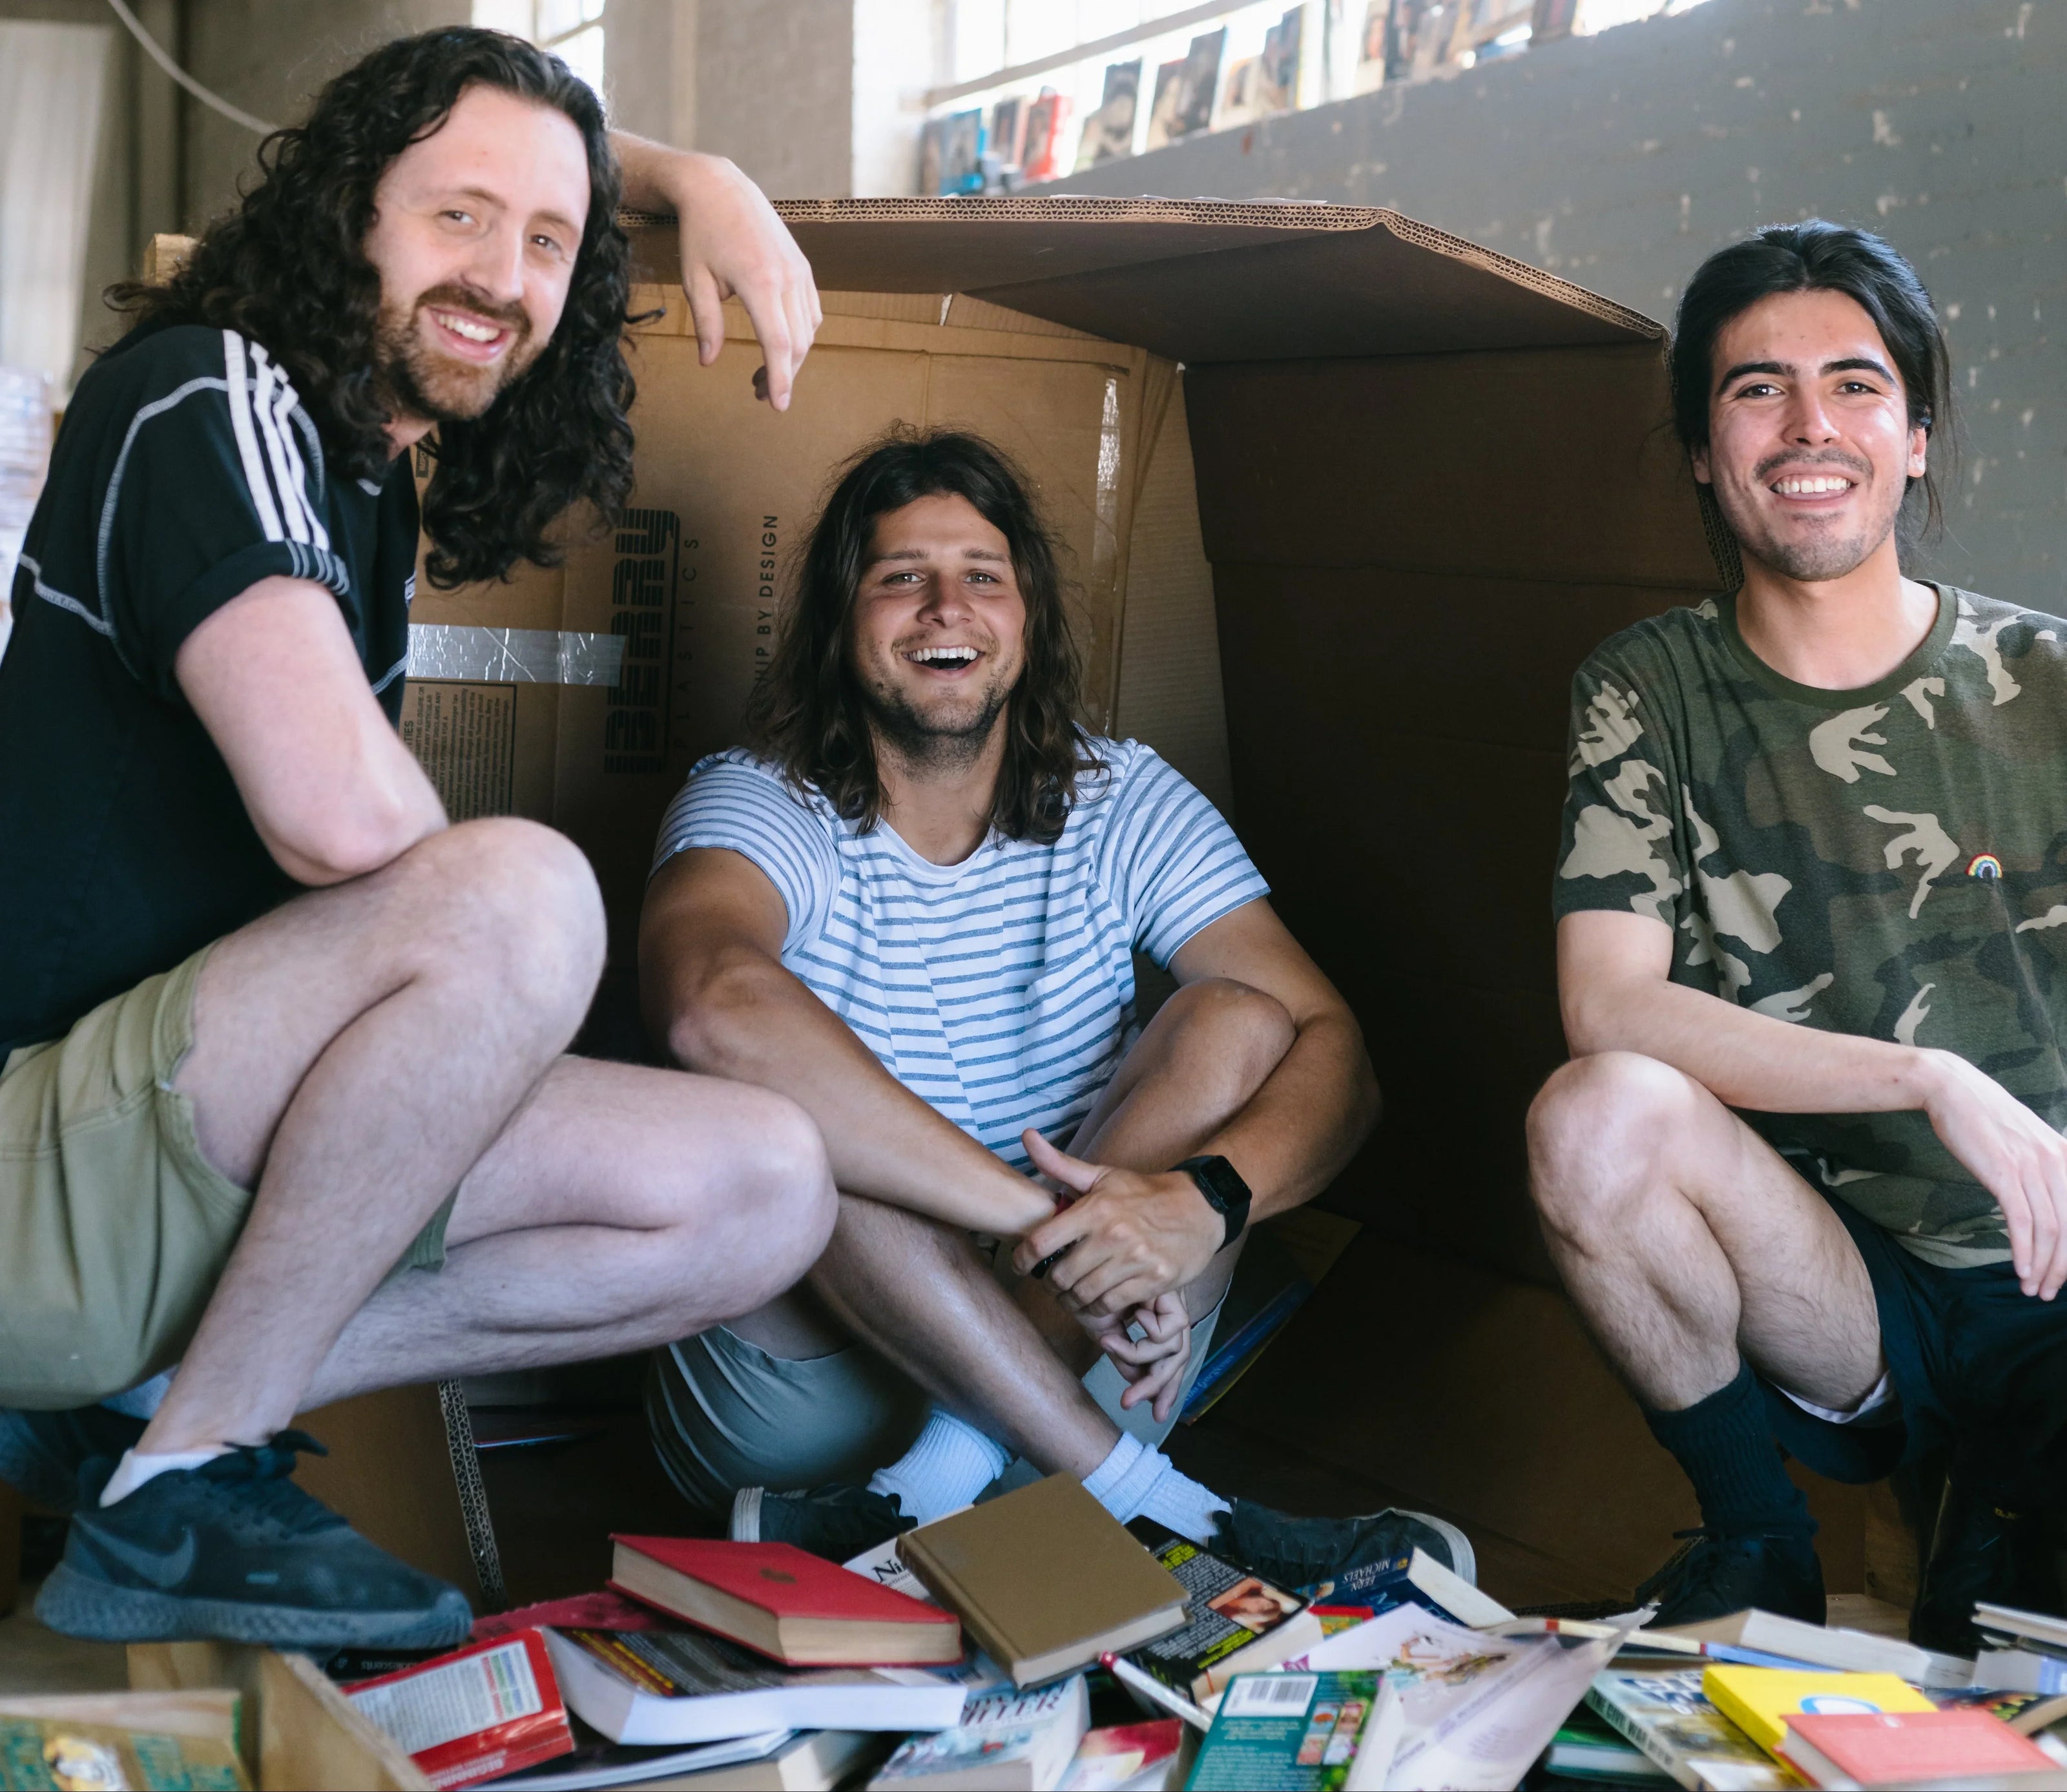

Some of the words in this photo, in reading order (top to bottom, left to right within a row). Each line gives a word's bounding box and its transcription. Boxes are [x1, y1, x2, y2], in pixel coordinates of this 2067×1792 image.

[759, 515, 778, 597] DESIGN
[605, 508, 680, 751] BERRY
[674, 538, 700, 750] PLASTICS
[756, 610, 773, 635] BY
[871, 1559, 905, 1584] Ni
[1343, 1558, 1391, 1583] MICHAELS
